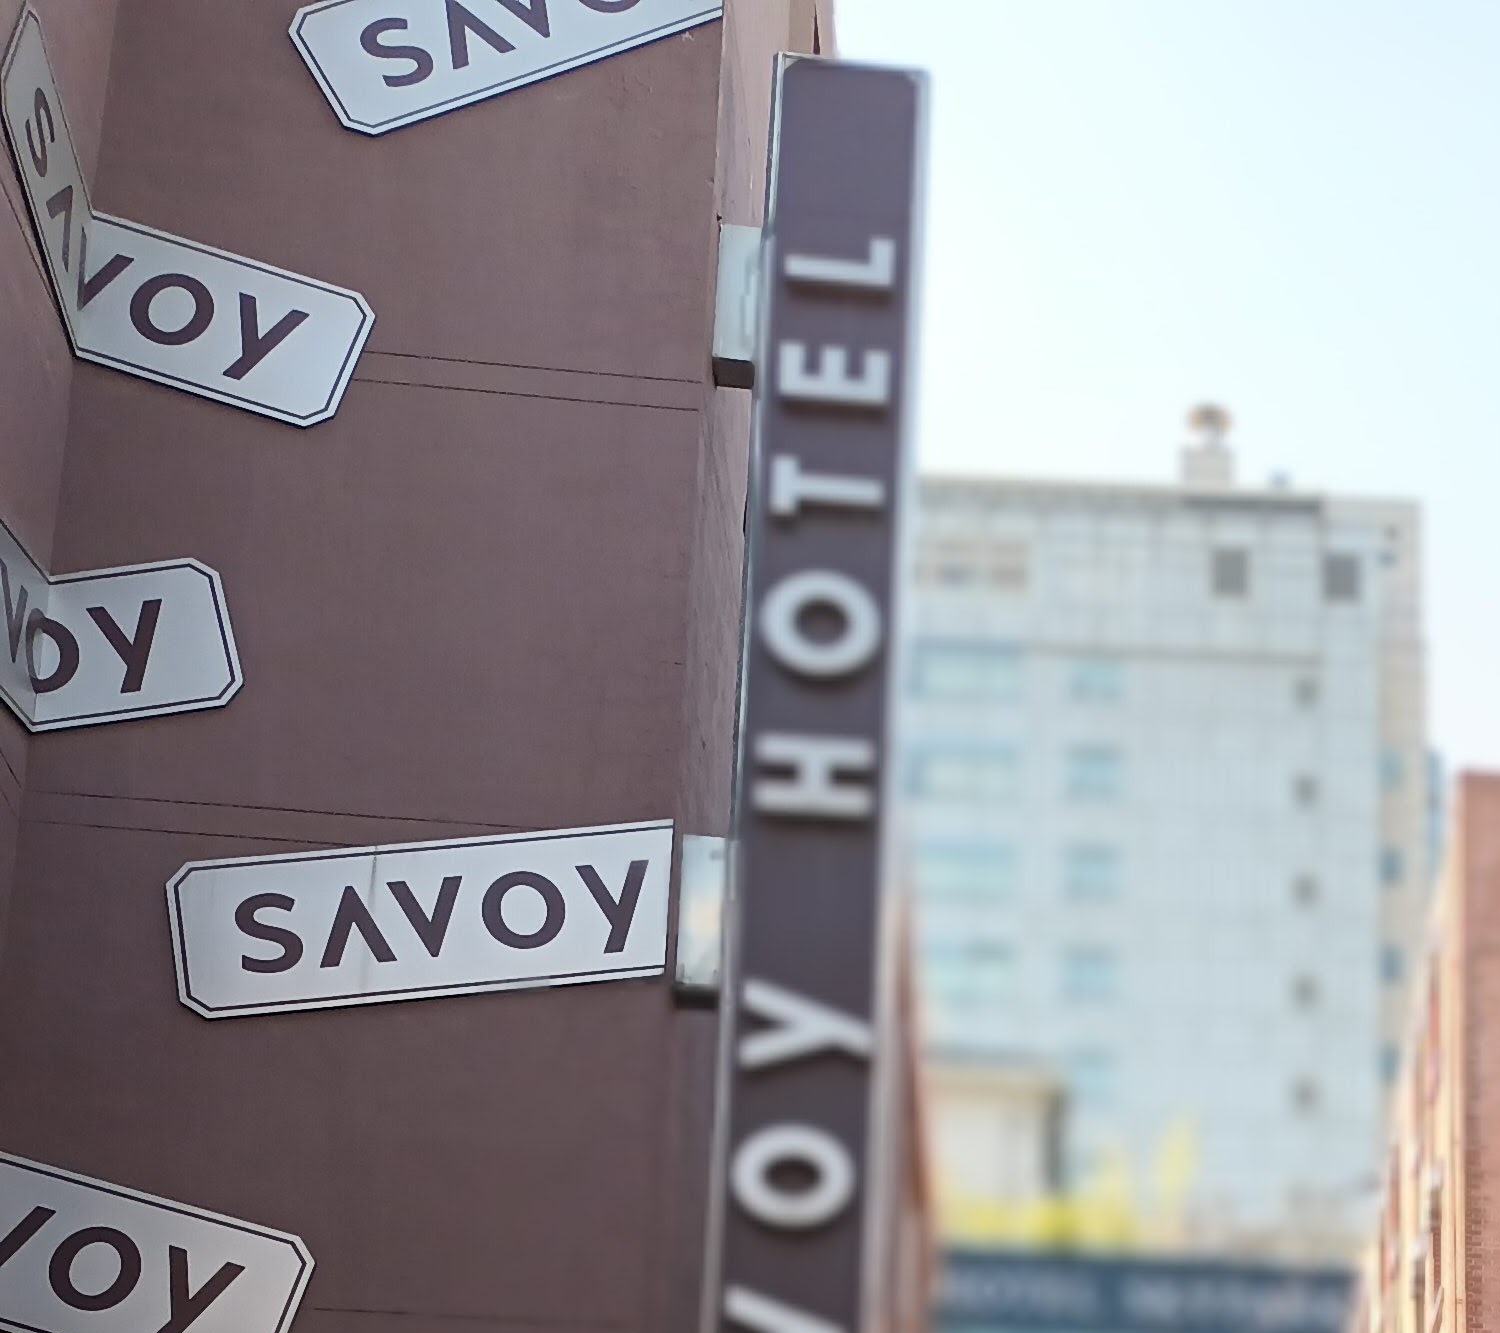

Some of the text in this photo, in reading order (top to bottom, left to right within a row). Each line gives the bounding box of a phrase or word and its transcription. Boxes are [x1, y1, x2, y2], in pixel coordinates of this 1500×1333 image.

[23, 86, 310, 381] SAVOY
[753, 236, 896, 819] HOTEL
[233, 858, 650, 975] SAVOY
